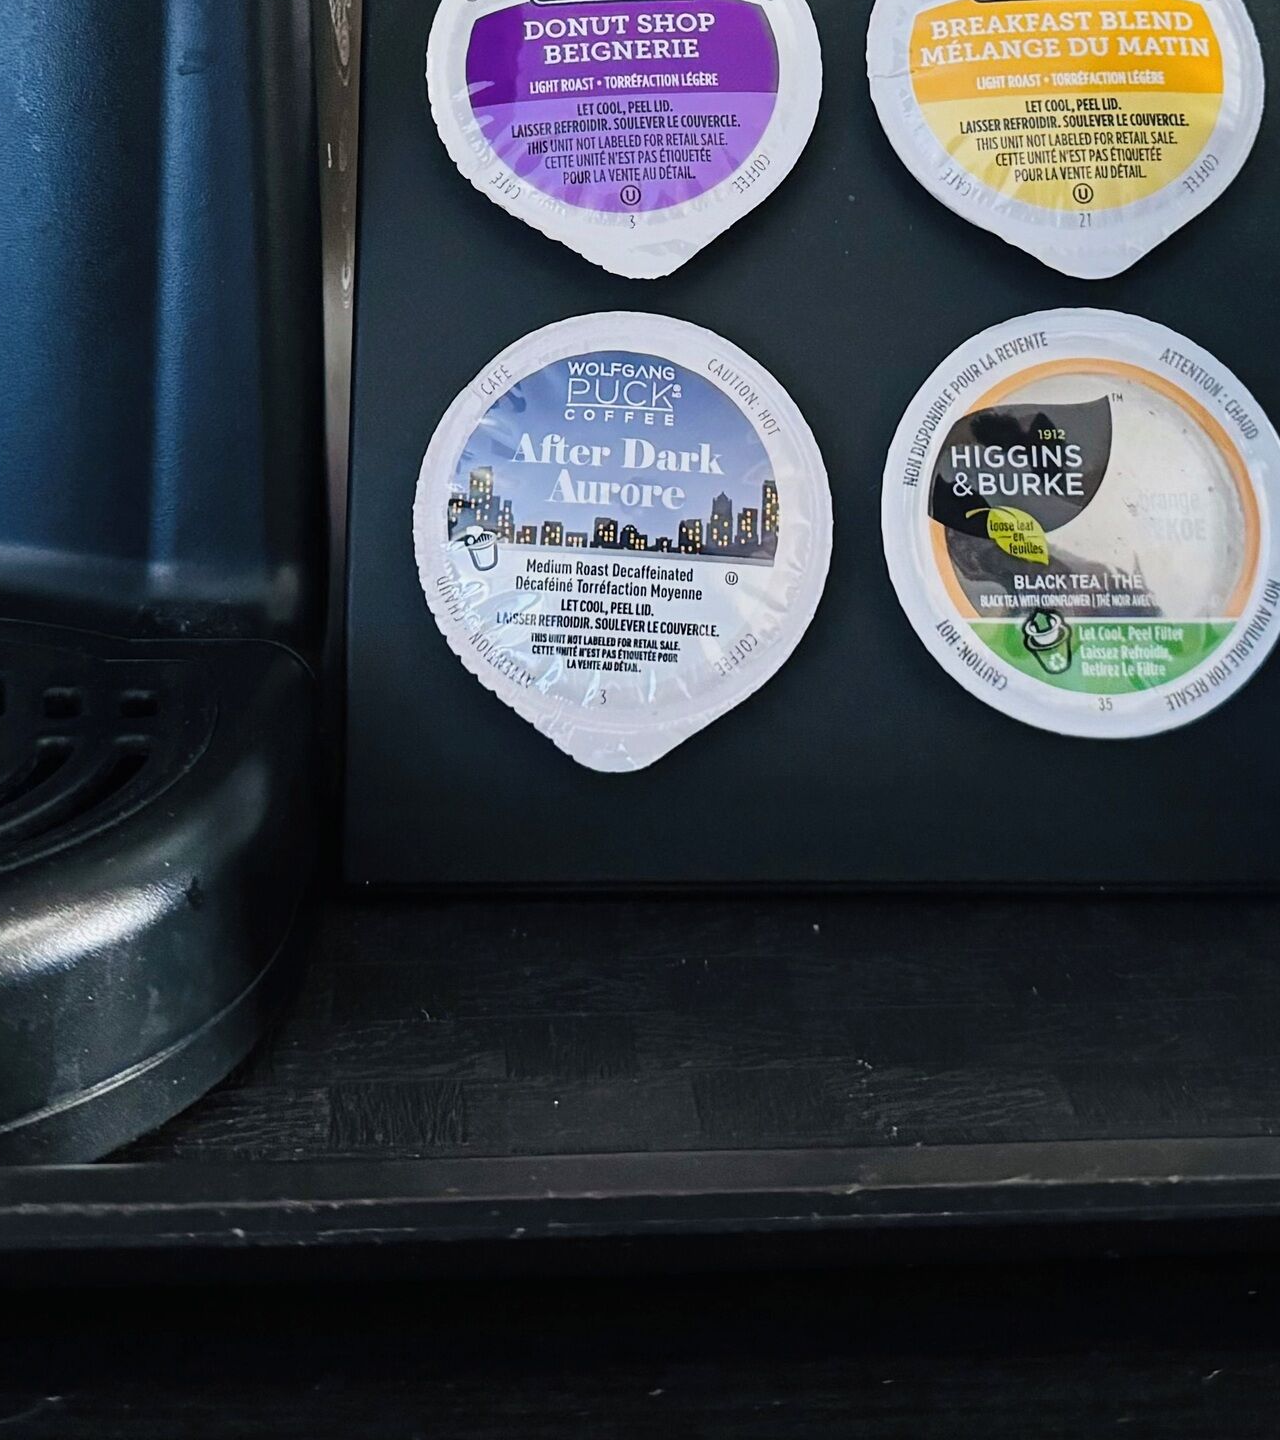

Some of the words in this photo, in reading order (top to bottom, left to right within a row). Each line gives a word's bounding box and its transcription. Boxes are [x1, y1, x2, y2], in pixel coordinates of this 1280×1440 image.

[524, 15, 629, 40] DONUT
[637, 13, 716, 34] SHOP
[930, 12, 1092, 40] BREAKFAST
[1101, 10, 1194, 32] BLEND
[544, 39, 700, 64] BEIGNERIE
[920, 39, 1062, 68] MÉLANGE
[1069, 37, 1110, 58] DU
[1117, 36, 1210, 58] MATIN
[529, 80, 558, 94] LIGHT
[561, 77, 594, 92] ROAST
[604, 73, 679, 89] TORRÉFACTION
[681, 71, 719, 87] LÉGÈRE
[976, 75, 1005, 90] LIGHT
[1007, 74, 1041, 88] ROAST
[1051, 70, 1126, 86] TORRÉFACTION
[577, 103, 595, 116] LET
[597, 102, 626, 115] COOL,
[628, 100, 653, 113] PEEL
[654, 100, 673, 112] LID.
[1025, 100, 1042, 113] LET
[1044, 99, 1075, 112] COOL,
[1077, 98, 1101, 111] PEEL
[1102, 98, 1122, 110] LID.
[511, 122, 552, 138] LAISSER
[554, 119, 612, 135] REFROIDIR.
[613, 116, 665, 130] SOULEVER
[667, 115, 678, 128] LE
[680, 114, 741, 128] COUVERCLE.
[960, 119, 1001, 134] LAISSER
[1003, 116, 1061, 131] REFROIDIR.
[1063, 114, 1114, 128] SOULEVER
[1117, 114, 1128, 126] LE
[1130, 113, 1190, 127] COUVERCLE.
[527, 140, 548, 155] THIS
[550, 138, 573, 152] UNIT
[576, 137, 596, 150] NOT
[598, 135, 641, 149] LABELED
[644, 134, 663, 147] FOR
[666, 133, 699, 146] RETAIL
[701, 132, 728, 146] SALE.
[976, 137, 998, 151] THIS
[1000, 135, 1024, 149] UNIT
[1026, 134, 1046, 148] NOT
[1049, 132, 1091, 146] LABELED
[1094, 132, 1113, 144] FOR
[1116, 131, 1149, 144] RETAIL
[545, 154, 574, 169] CETTE
[576, 151, 606, 167] UNITÉ
[608, 151, 635, 165] N'EST
[638, 150, 658, 164] PAS
[659, 147, 712, 164] ÉTIQUETÉE
[995, 152, 1025, 166] CETTE
[1027, 148, 1057, 164] UNITÉ
[1059, 149, 1087, 163] N'EST
[1089, 149, 1108, 162] PAS
[1110, 146, 1162, 162] ÉTIQUETÉE
[563, 170, 591, 185] POUR
[593, 170, 606, 183] LA
[608, 168, 640, 182] VENTE
[643, 167, 658, 180] AU
[660, 165, 696, 179] DÉTAIL.
[732, 153, 771, 194] COFFEE
[1014, 168, 1043, 182] POUR
[1045, 168, 1058, 181] LA
[1060, 166, 1092, 180] VENTE
[1094, 165, 1109, 179] AU
[1182, 153, 1220, 194] COFFEE
[1080, 213, 1091, 228] 21
[995, 331, 1049, 363] REVENTE
[567, 361, 675, 380] WOLFGANG
[979, 353, 998, 371] LA
[949, 363, 983, 395] POUR
[567, 377, 673, 409] PUCK
[707, 358, 760, 410] CAUTION:
[758, 409, 781, 435] HOT
[1158, 348, 1224, 397] ATTENTION
[1224, 399, 1260, 440] CHAUD
[564, 409, 674, 427] COFFEE
[910, 388, 956, 459] DISPONIBLE
[1038, 429, 1066, 440] 1912
[511, 432, 611, 467] After
[621, 437, 725, 475] Dark
[951, 444, 1083, 468] HIGGINS
[903, 459, 922, 487] NON
[545, 468, 686, 510] Aurore
[990, 520, 1014, 532] loose
[1016, 520, 1034, 531] leaf
[1013, 532, 1024, 542] en
[1009, 542, 1044, 554] feuilles
[526, 558, 572, 575] Medium
[576, 561, 608, 577] Roast
[612, 563, 693, 582] Decaffeinated
[1014, 574, 1066, 590] BLACK
[1069, 574, 1101, 589] TEA
[515, 575, 573, 593] Décaféiné
[577, 579, 647, 597] Torréfaction
[651, 583, 702, 601] Moyenne
[561, 598, 579, 612] LET
[580, 599, 608, 615] COOL,
[611, 601, 634, 615] PEEL
[636, 602, 654, 617] LID.
[496, 611, 537, 626] LAISSER
[538, 614, 593, 630] REFROIDIR.
[595, 617, 645, 633] SOULEVER
[647, 620, 659, 633] LE
[660, 621, 720, 637] COUVERCLE.
[936, 619, 961, 647] HOT
[1225, 604, 1272, 667] AVAILABLE
[714, 633, 758, 676] COFFEE
[956, 641, 1008, 691] CAUTION:
[1205, 660, 1232, 687] FOR
[600, 689, 607, 704] 3
[1098, 697, 1113, 711] 35
[1164, 677, 1209, 711] RESALE
